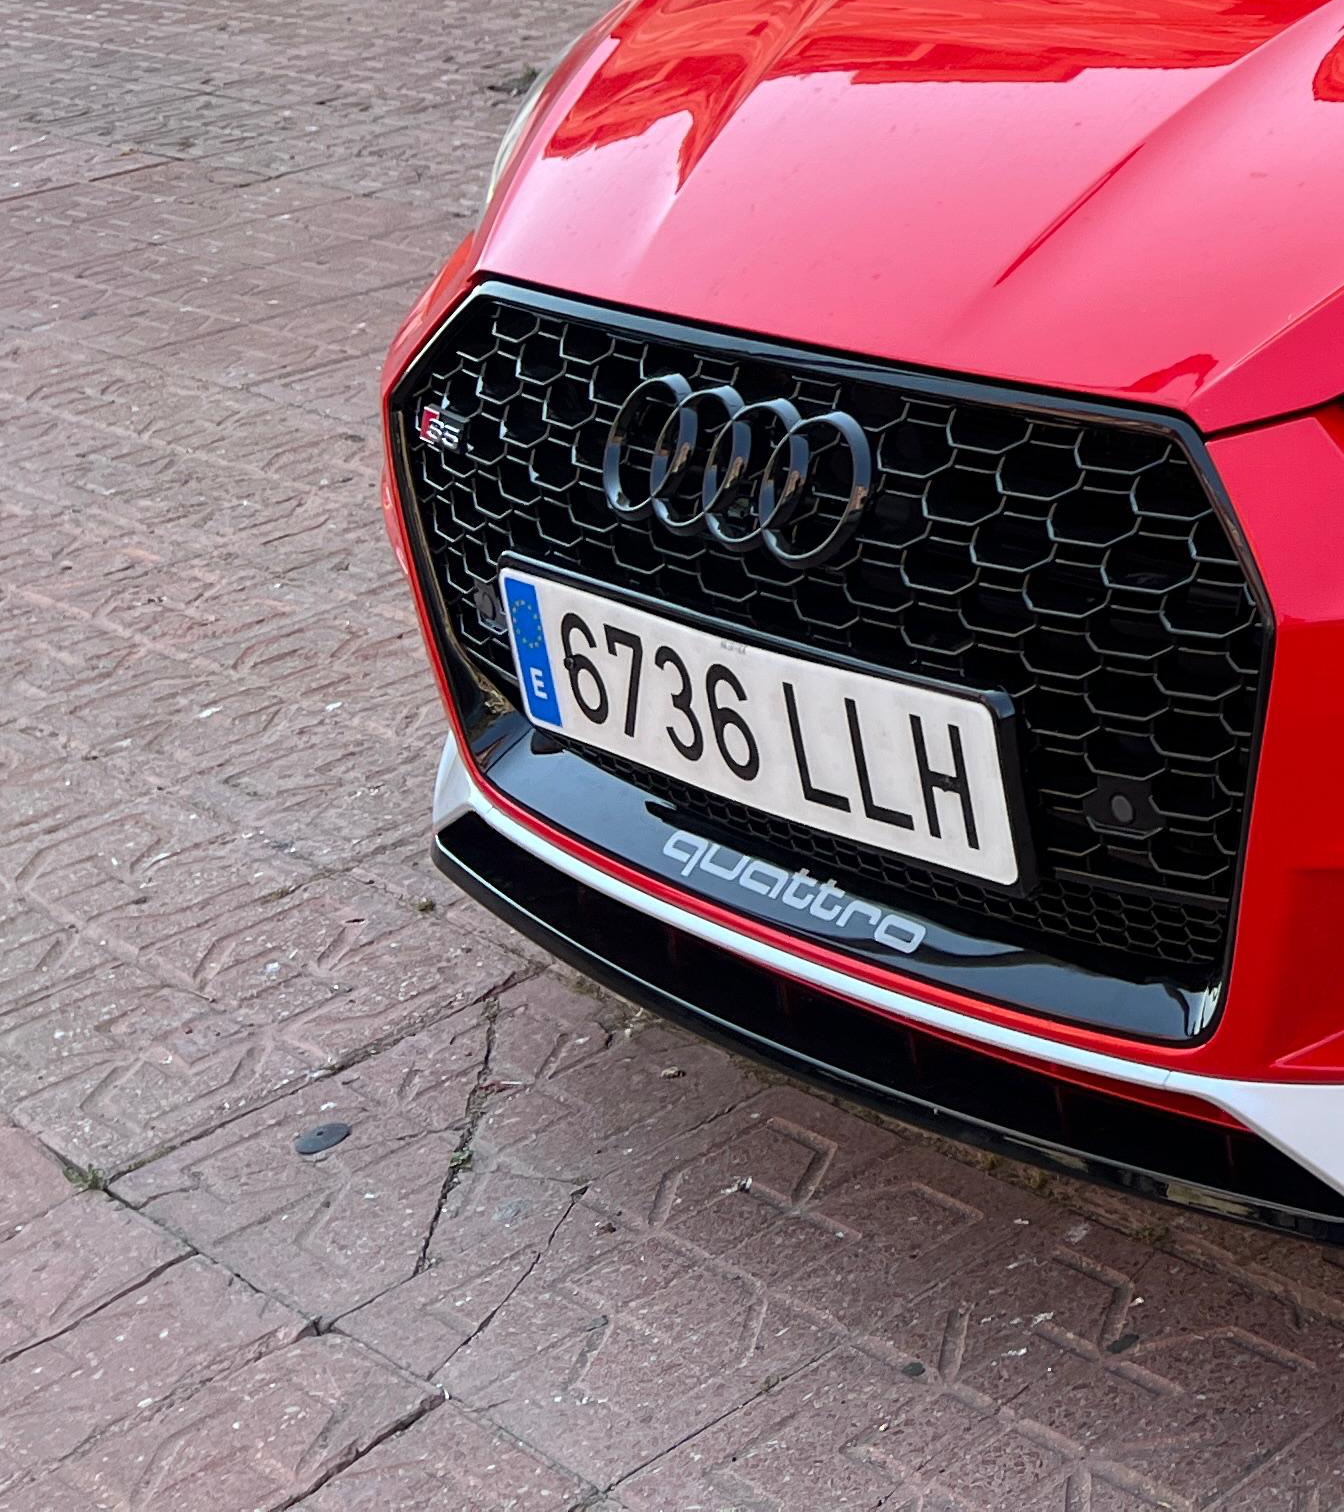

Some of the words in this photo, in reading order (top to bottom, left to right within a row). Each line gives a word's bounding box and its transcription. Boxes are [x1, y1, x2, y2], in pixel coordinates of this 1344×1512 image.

[531, 667, 548, 700] E
[560, 612, 760, 781] 6736
[782, 681, 980, 850] LLH
[662, 829, 926, 954] quattro
